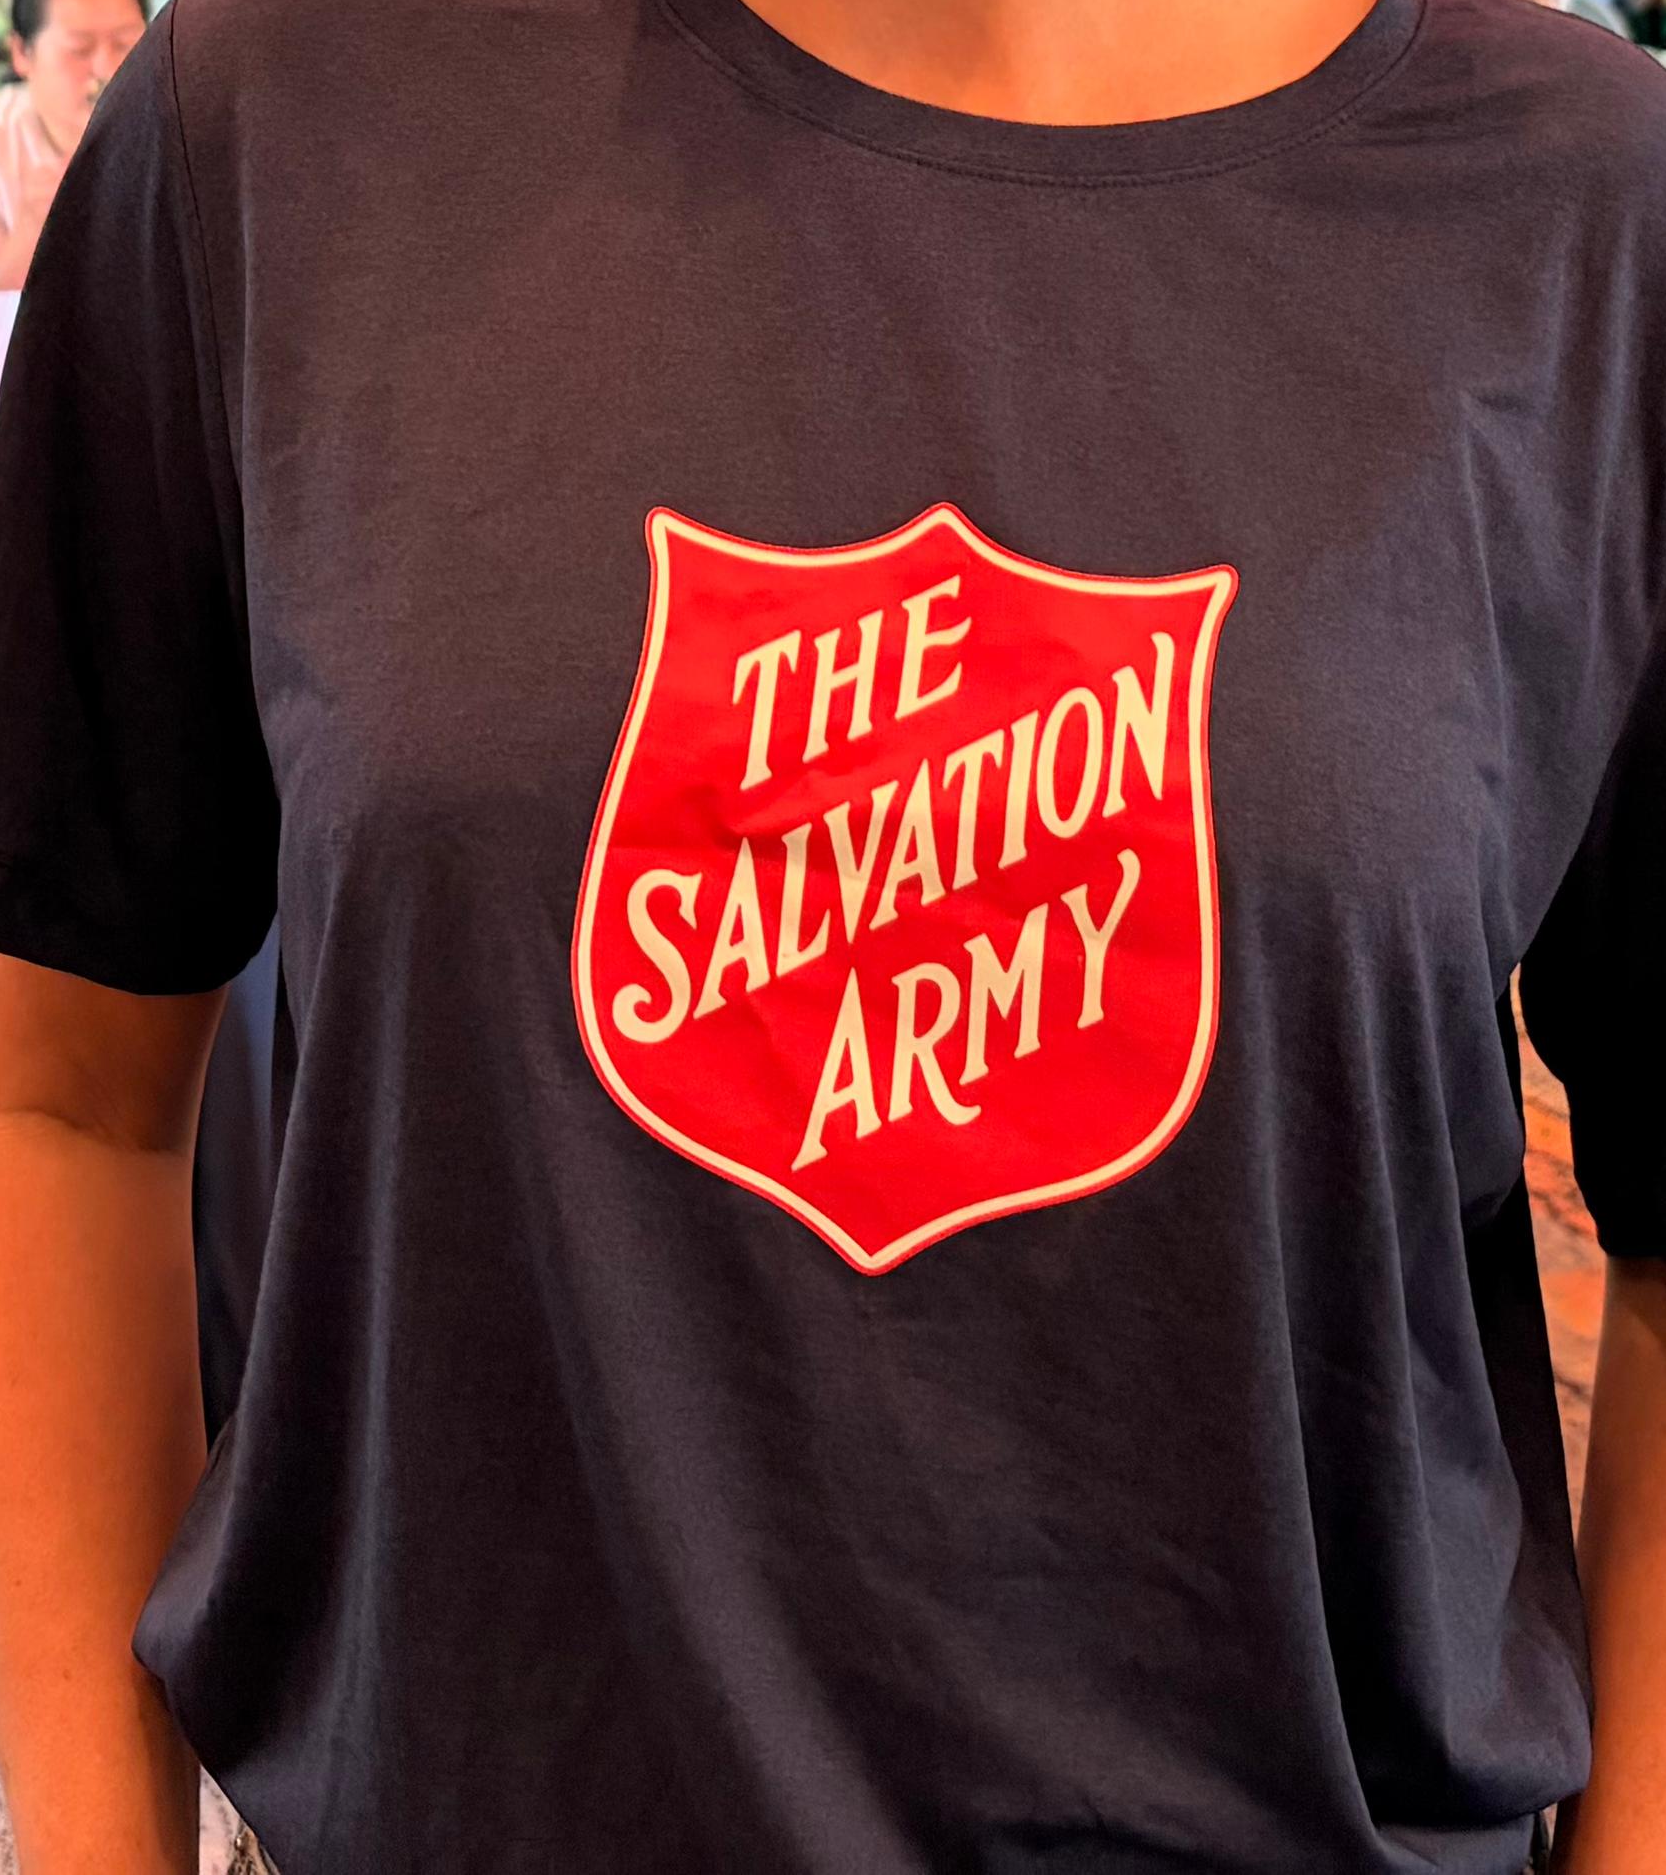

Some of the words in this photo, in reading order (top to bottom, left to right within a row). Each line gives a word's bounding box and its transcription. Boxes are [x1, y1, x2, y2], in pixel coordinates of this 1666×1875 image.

[612, 631, 1175, 1044] SALVATION
[733, 574, 972, 791] THE
[791, 849, 1141, 1173] ARMY
